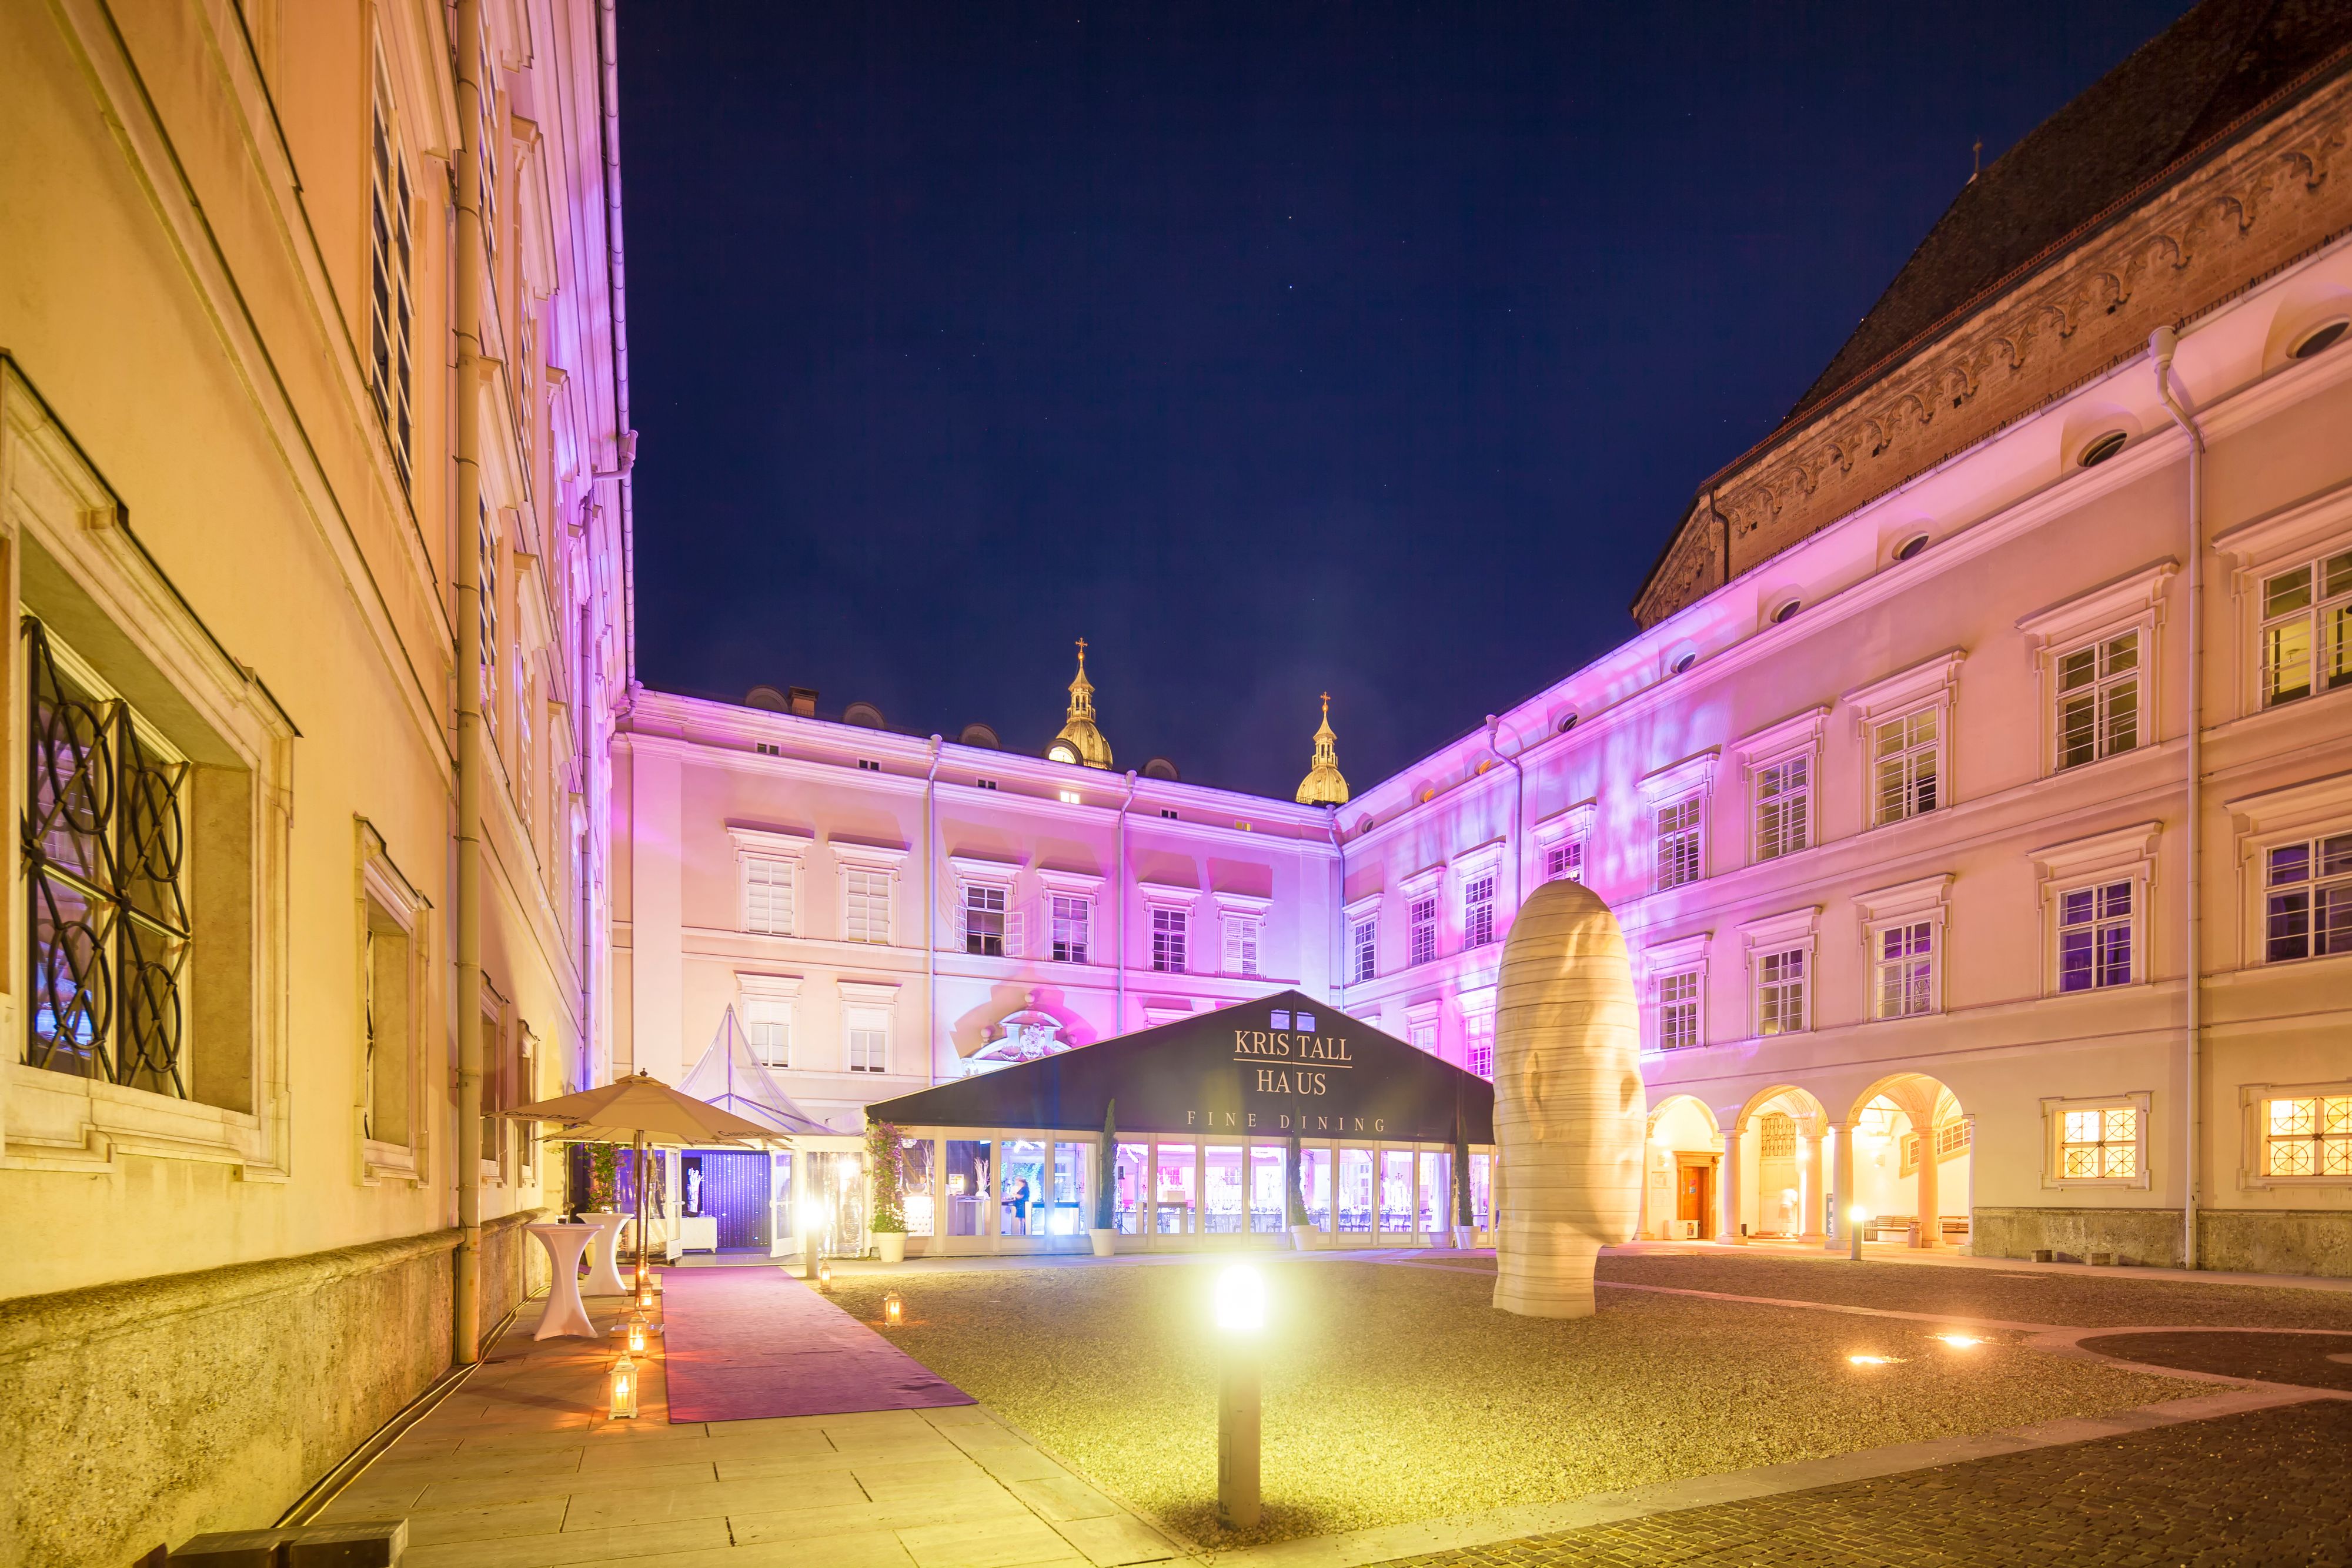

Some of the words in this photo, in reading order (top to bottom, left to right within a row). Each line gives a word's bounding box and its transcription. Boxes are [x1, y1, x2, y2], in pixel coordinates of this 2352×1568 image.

[1256, 1069, 1327, 1095] HAUS
[1187, 1111, 1257, 1128] FINE
[1279, 1115, 1385, 1132] DINING
